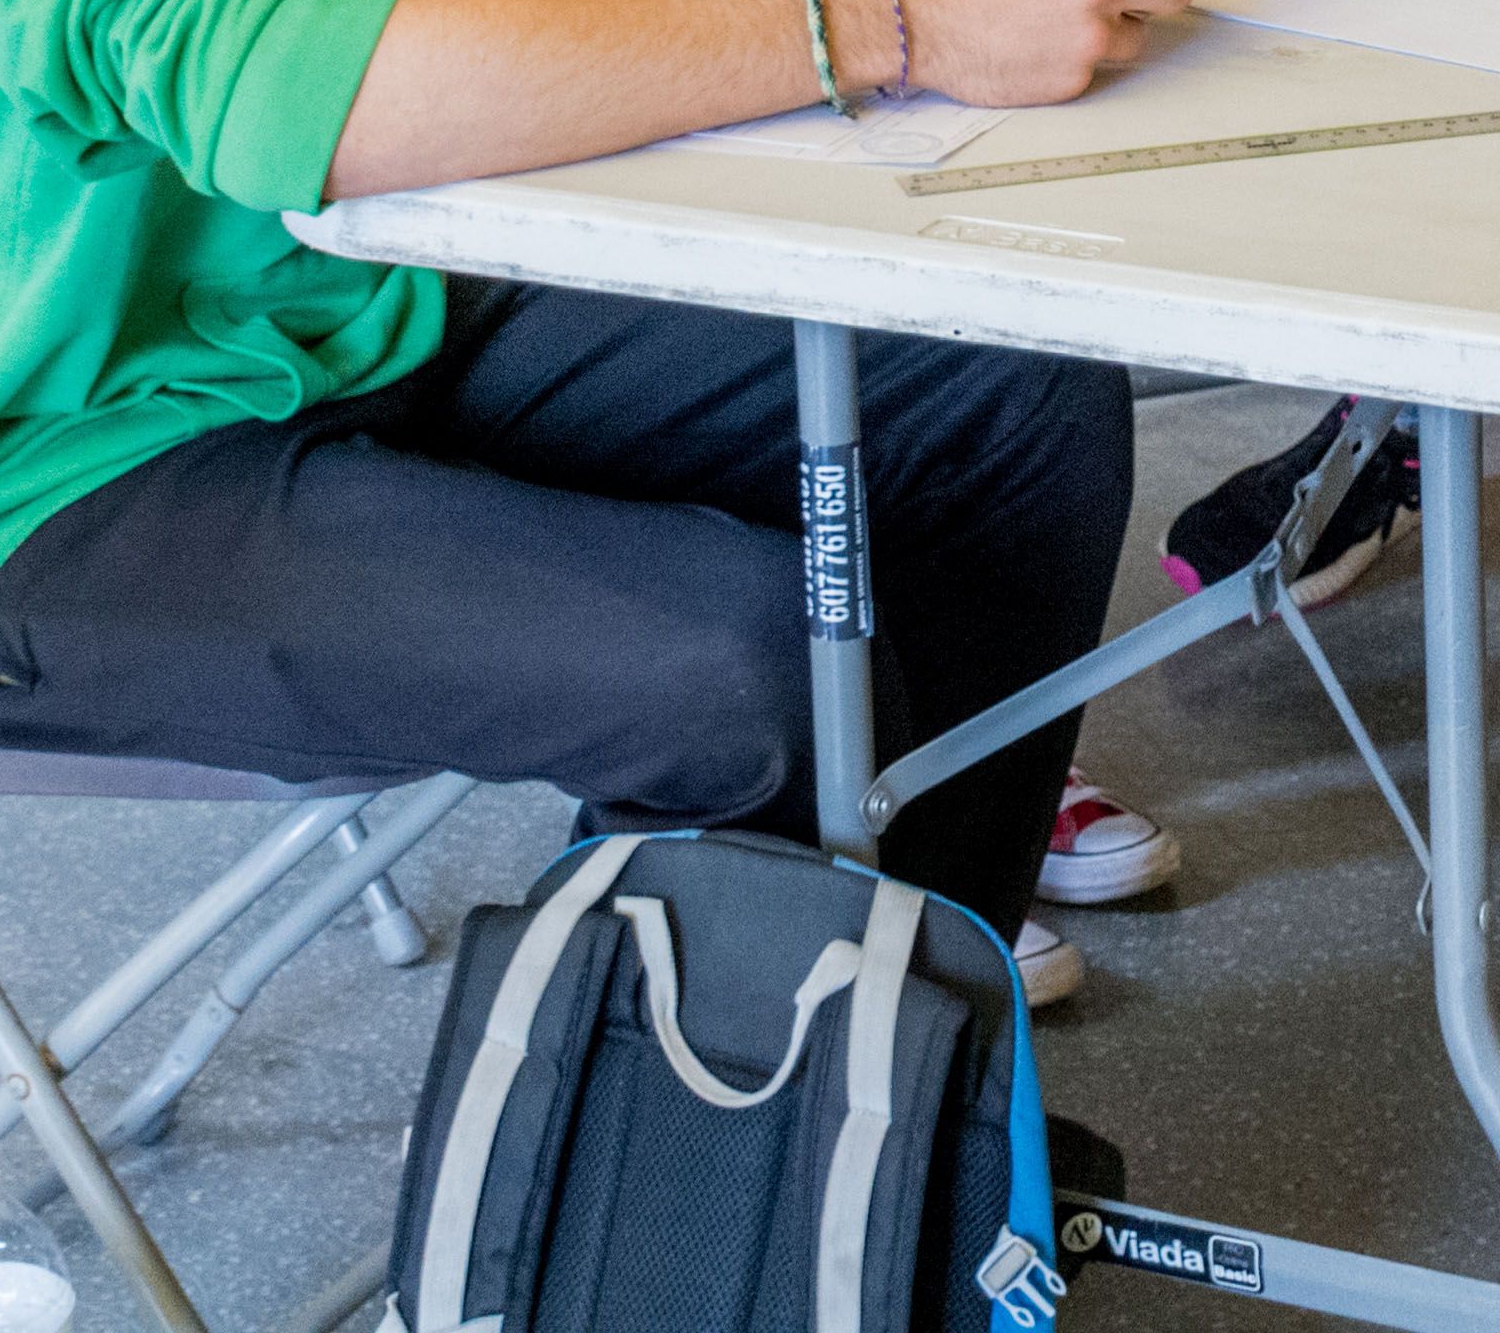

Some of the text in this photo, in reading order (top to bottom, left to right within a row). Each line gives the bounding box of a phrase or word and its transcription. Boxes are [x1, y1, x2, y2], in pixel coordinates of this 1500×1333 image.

[813, 464, 850, 624] 607 761 650
[1105, 1225, 1205, 1273] Viada
